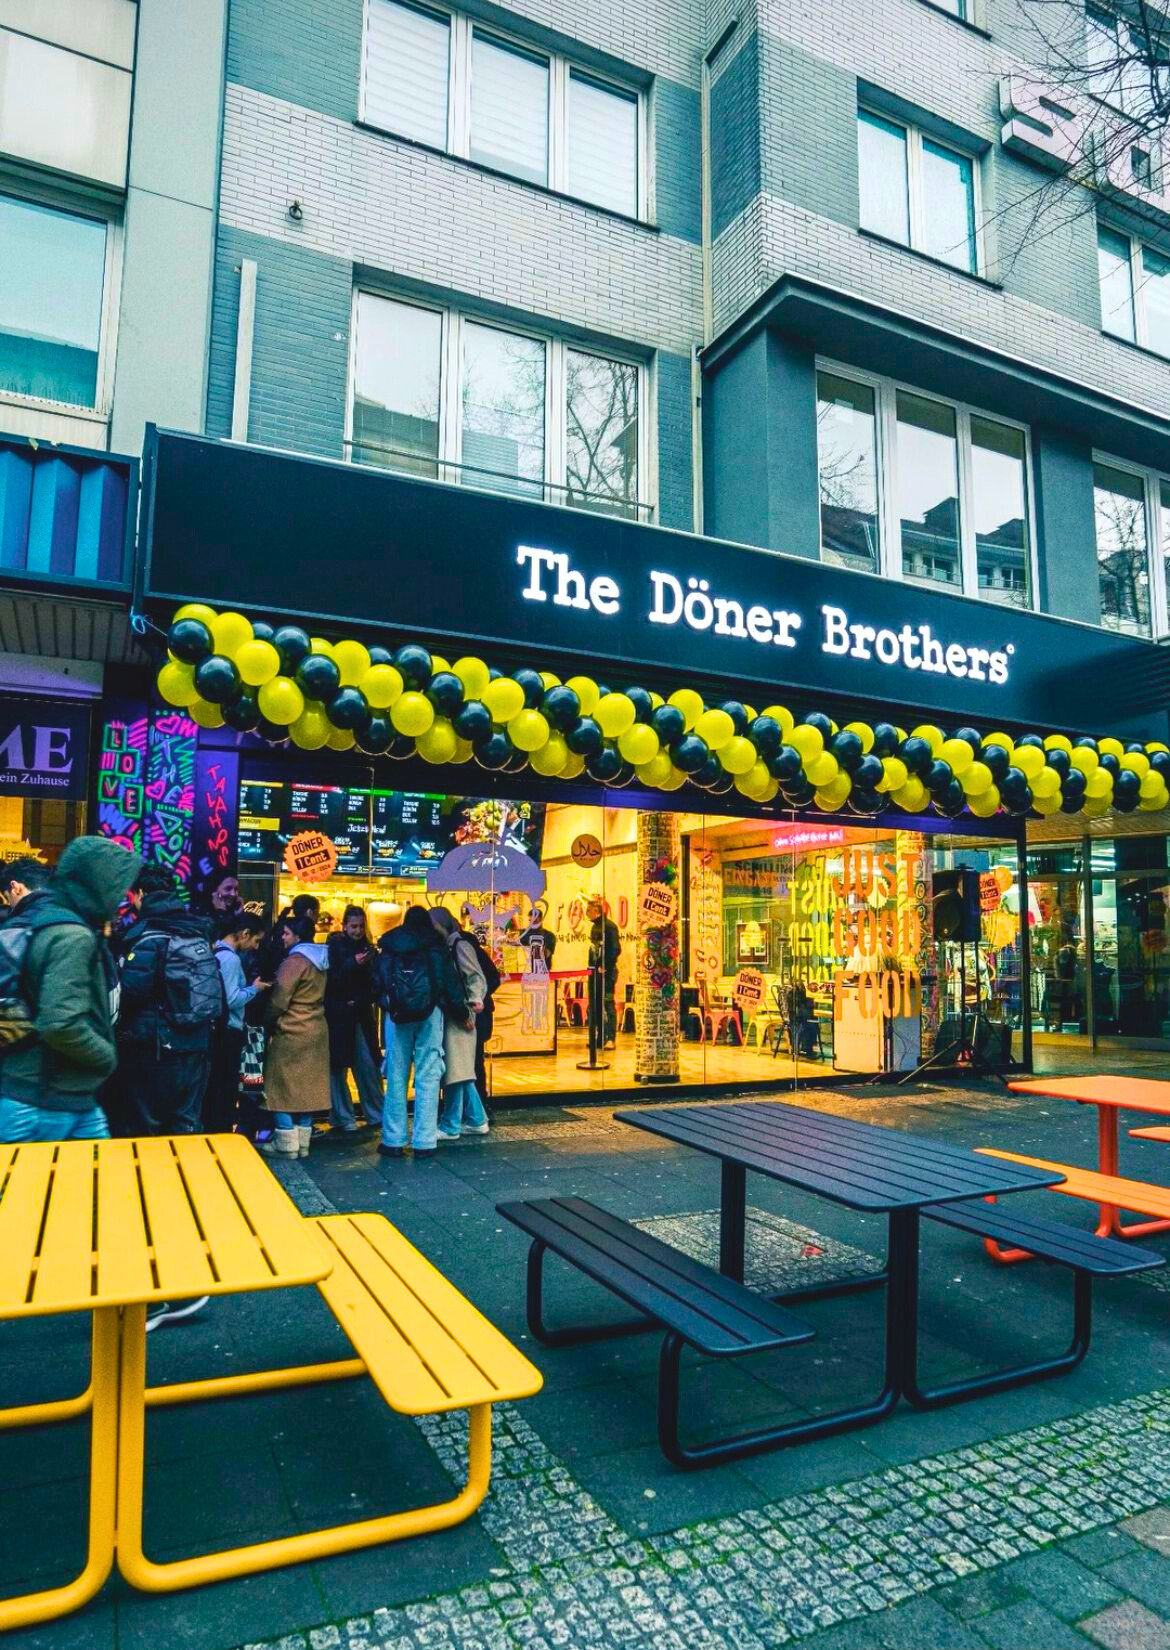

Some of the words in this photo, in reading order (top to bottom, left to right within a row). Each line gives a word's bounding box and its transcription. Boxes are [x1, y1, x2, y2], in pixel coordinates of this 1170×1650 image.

[516, 544, 621, 616] The
[648, 569, 802, 650] Döner
[20, 773, 70, 787] Zuhause
[291, 836, 324, 855] DÖNER
[298, 858, 304, 869] 1
[832, 849, 921, 898] JUST
[833, 910, 922, 957] GOOD
[834, 970, 922, 1022] FOOD
